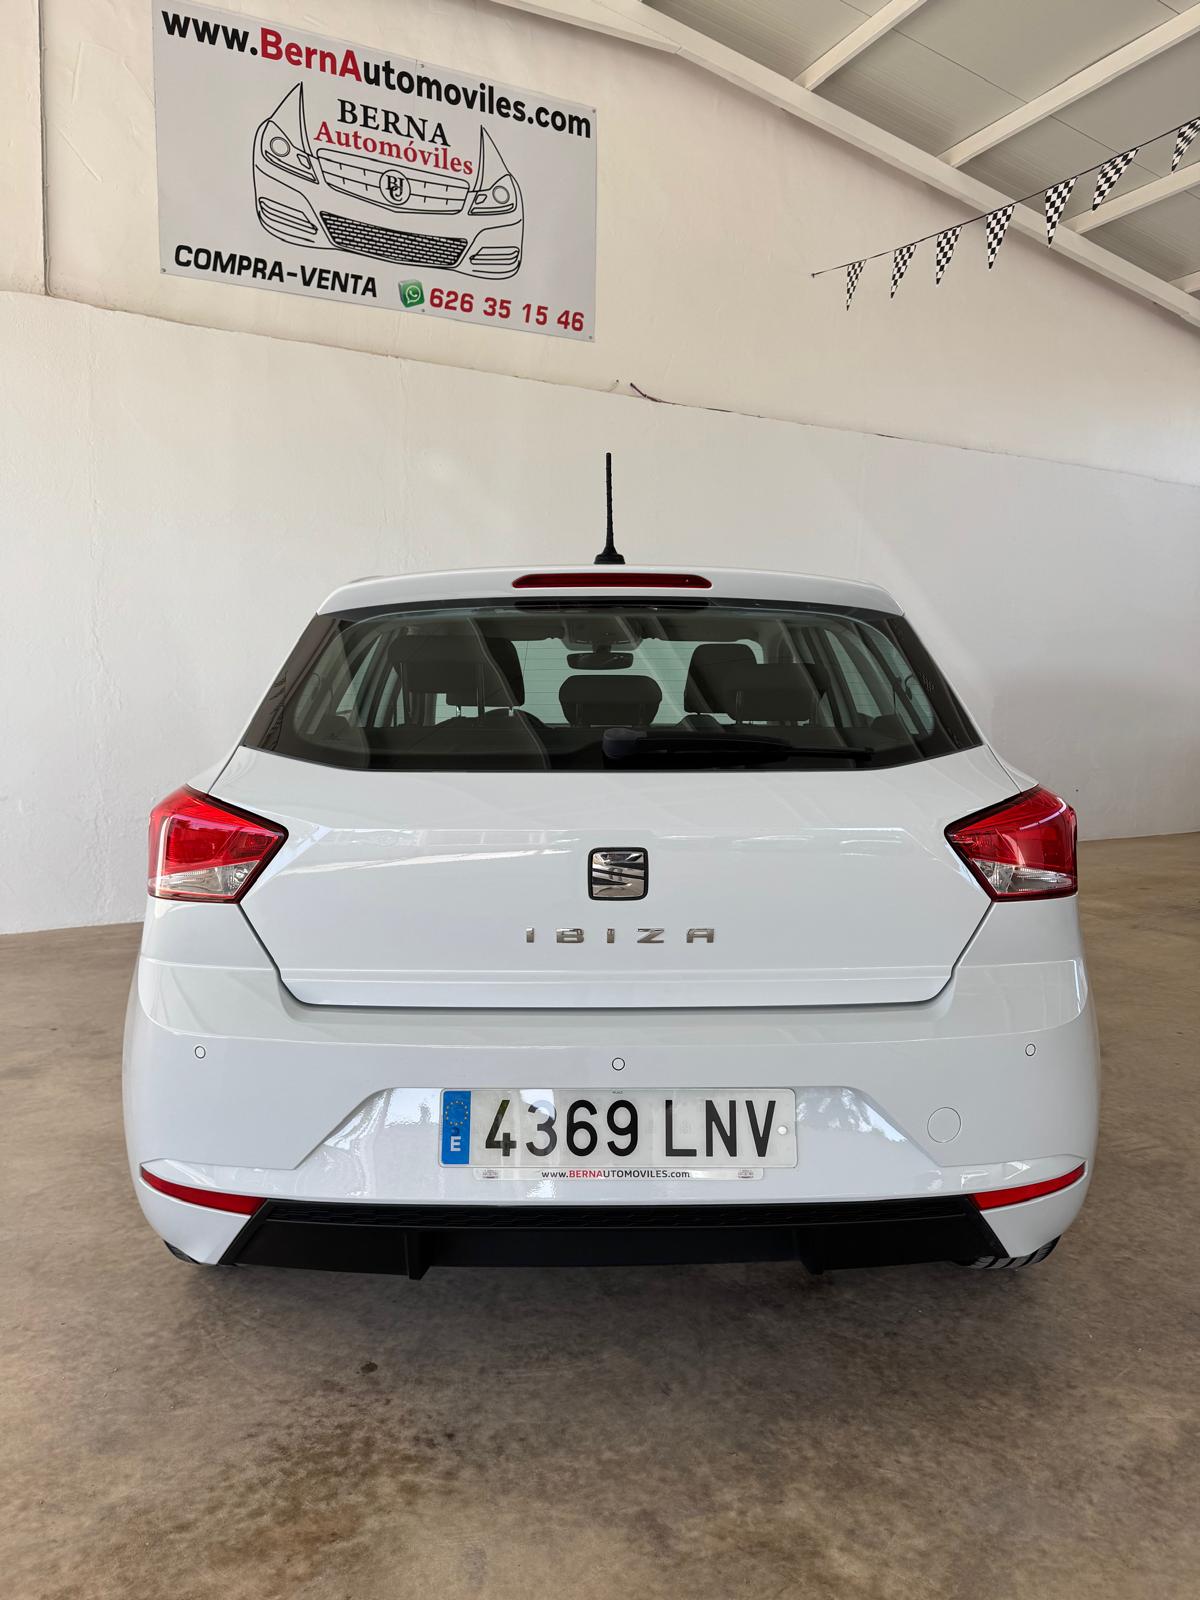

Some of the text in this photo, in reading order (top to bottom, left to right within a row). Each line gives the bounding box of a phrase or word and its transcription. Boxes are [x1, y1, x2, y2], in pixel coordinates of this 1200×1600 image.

[161, 10, 592, 139] www.BernAutomoviles.com
[313, 121, 474, 175] Automóviles
[337, 98, 452, 147] BERNA
[174, 244, 378, 298] COMPRA-VENTA
[429, 287, 585, 332] 626 35 15 46
[526, 927, 715, 944] IBIZA
[450, 1099, 777, 1158] E 4369 LNV
[541, 1169, 691, 1179] www.BERNAUTOMOVILES.com
